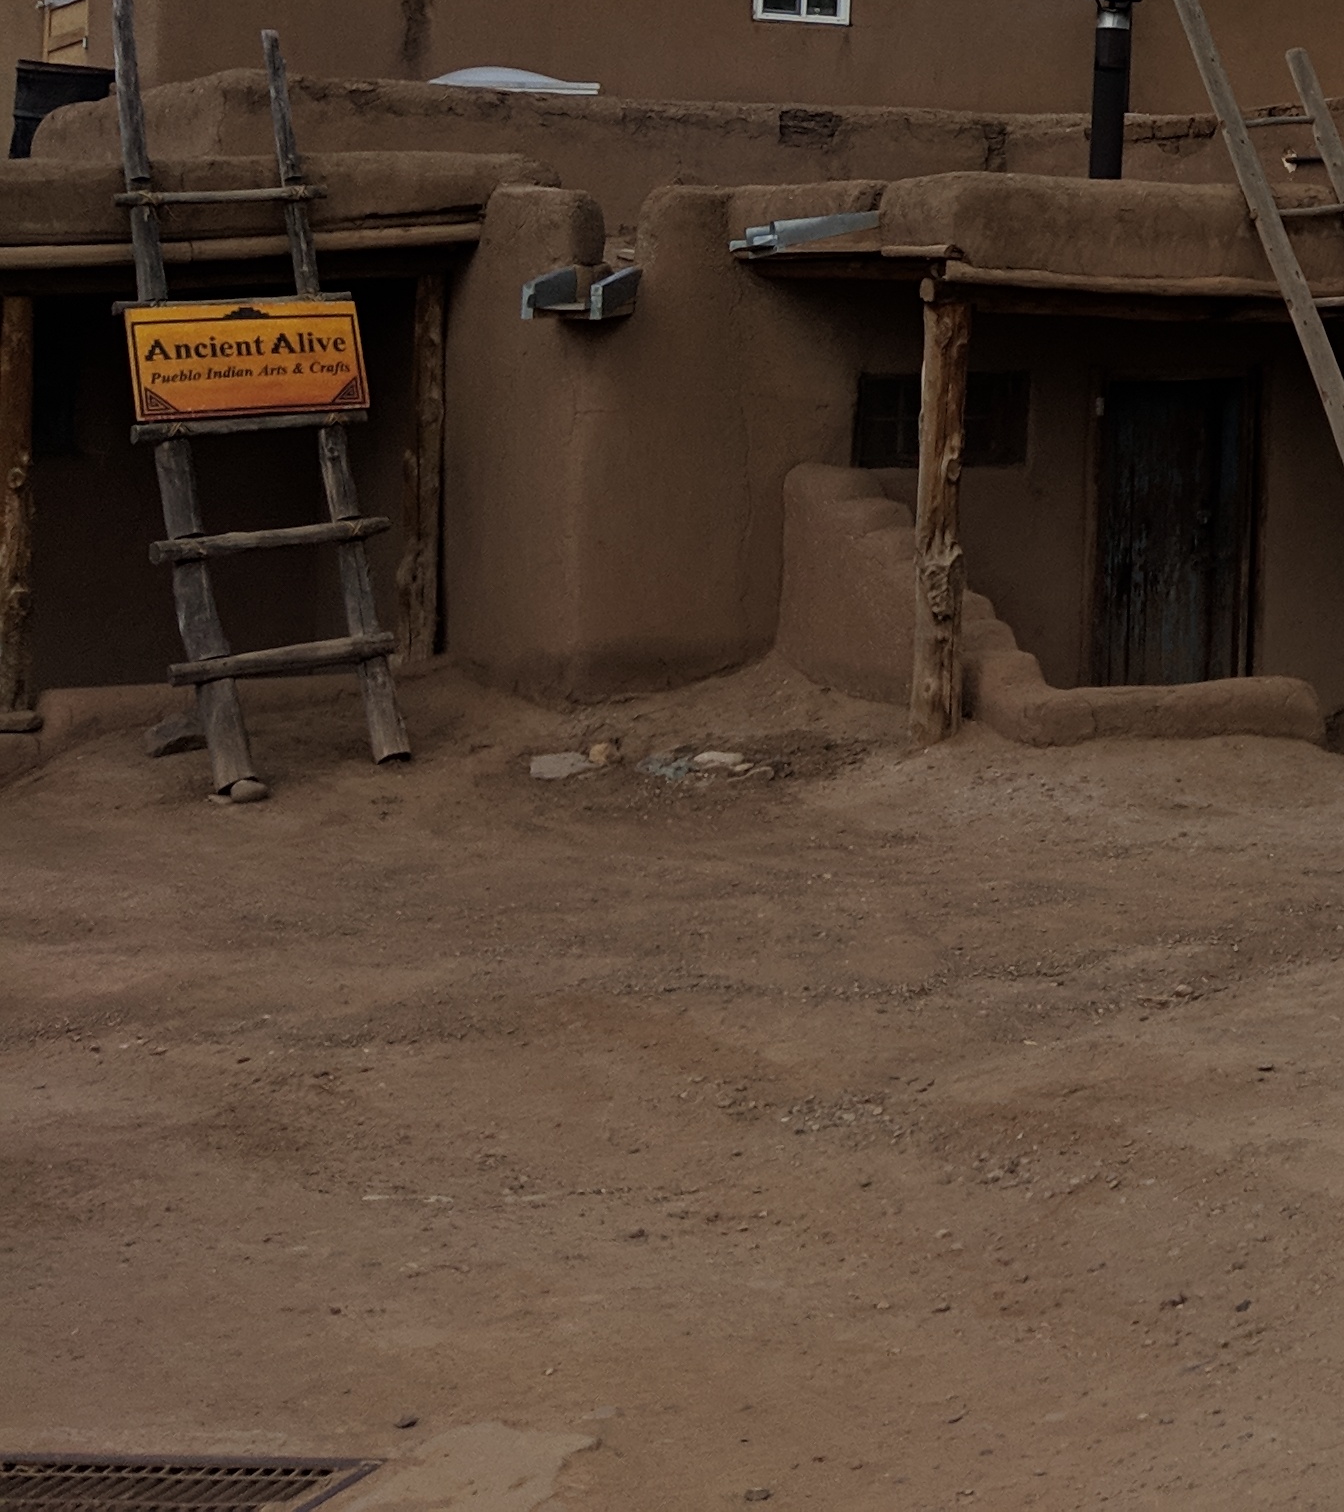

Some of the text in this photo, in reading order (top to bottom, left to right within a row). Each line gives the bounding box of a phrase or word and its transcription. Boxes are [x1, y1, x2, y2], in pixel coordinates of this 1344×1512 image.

[145, 332, 347, 361] Ancient Alive
[151, 361, 350, 384] Pueblo Indian Arts & Crafts
